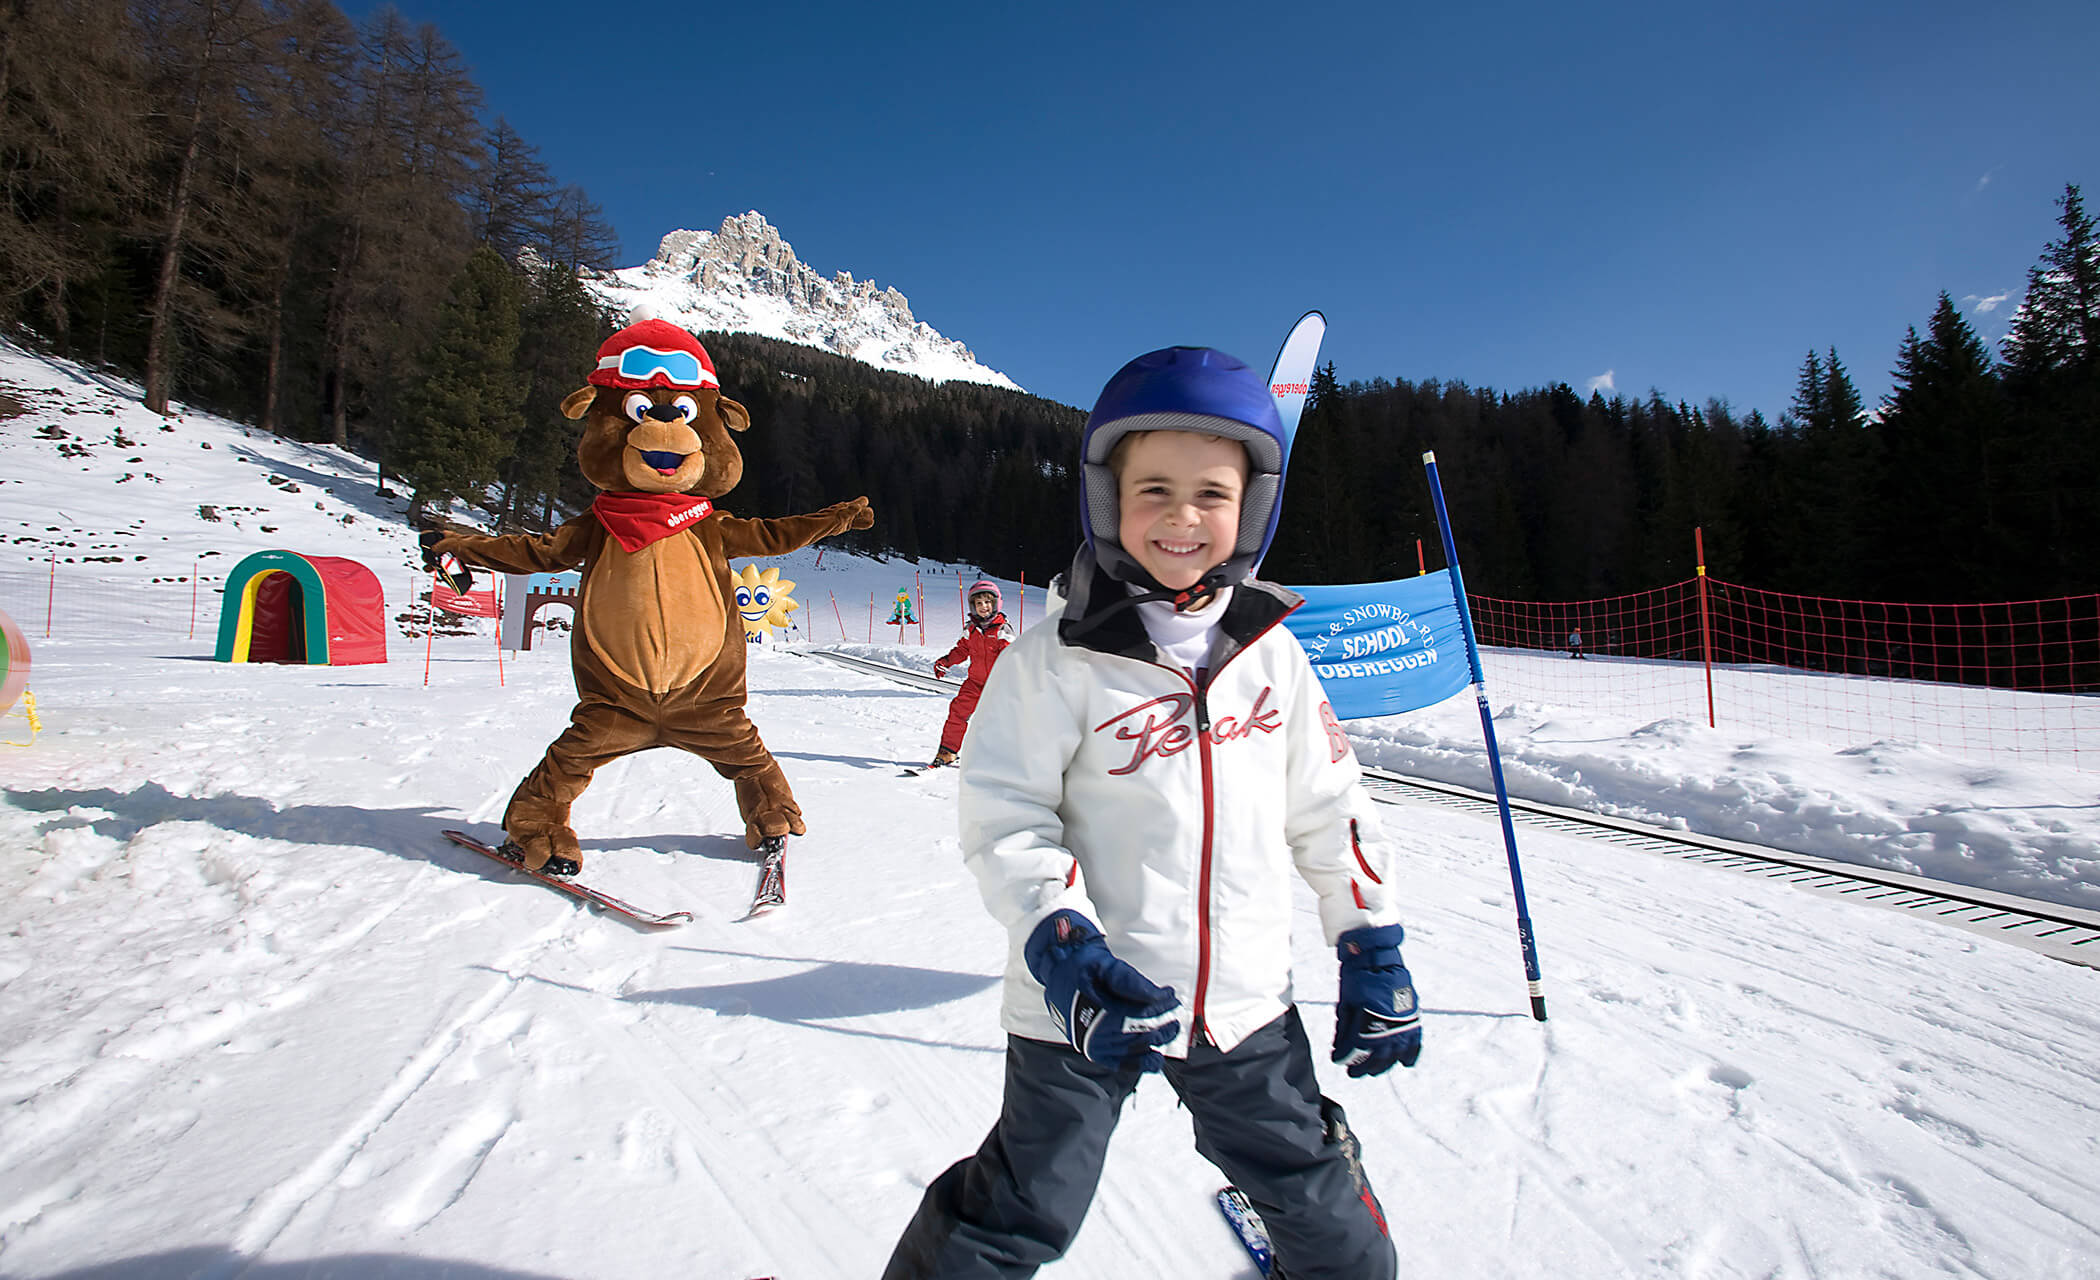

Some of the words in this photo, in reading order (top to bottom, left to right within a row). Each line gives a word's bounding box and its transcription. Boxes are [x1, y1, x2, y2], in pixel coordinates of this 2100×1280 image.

[1308, 633, 1331, 662] SKI
[1329, 622, 1344, 636] &
[1343, 603, 1434, 648] SNOWBOARD
[1342, 625, 1410, 660] SCHOOL
[1317, 648, 1438, 679] OBEREGGEN
[1094, 686, 1283, 775] Peak
